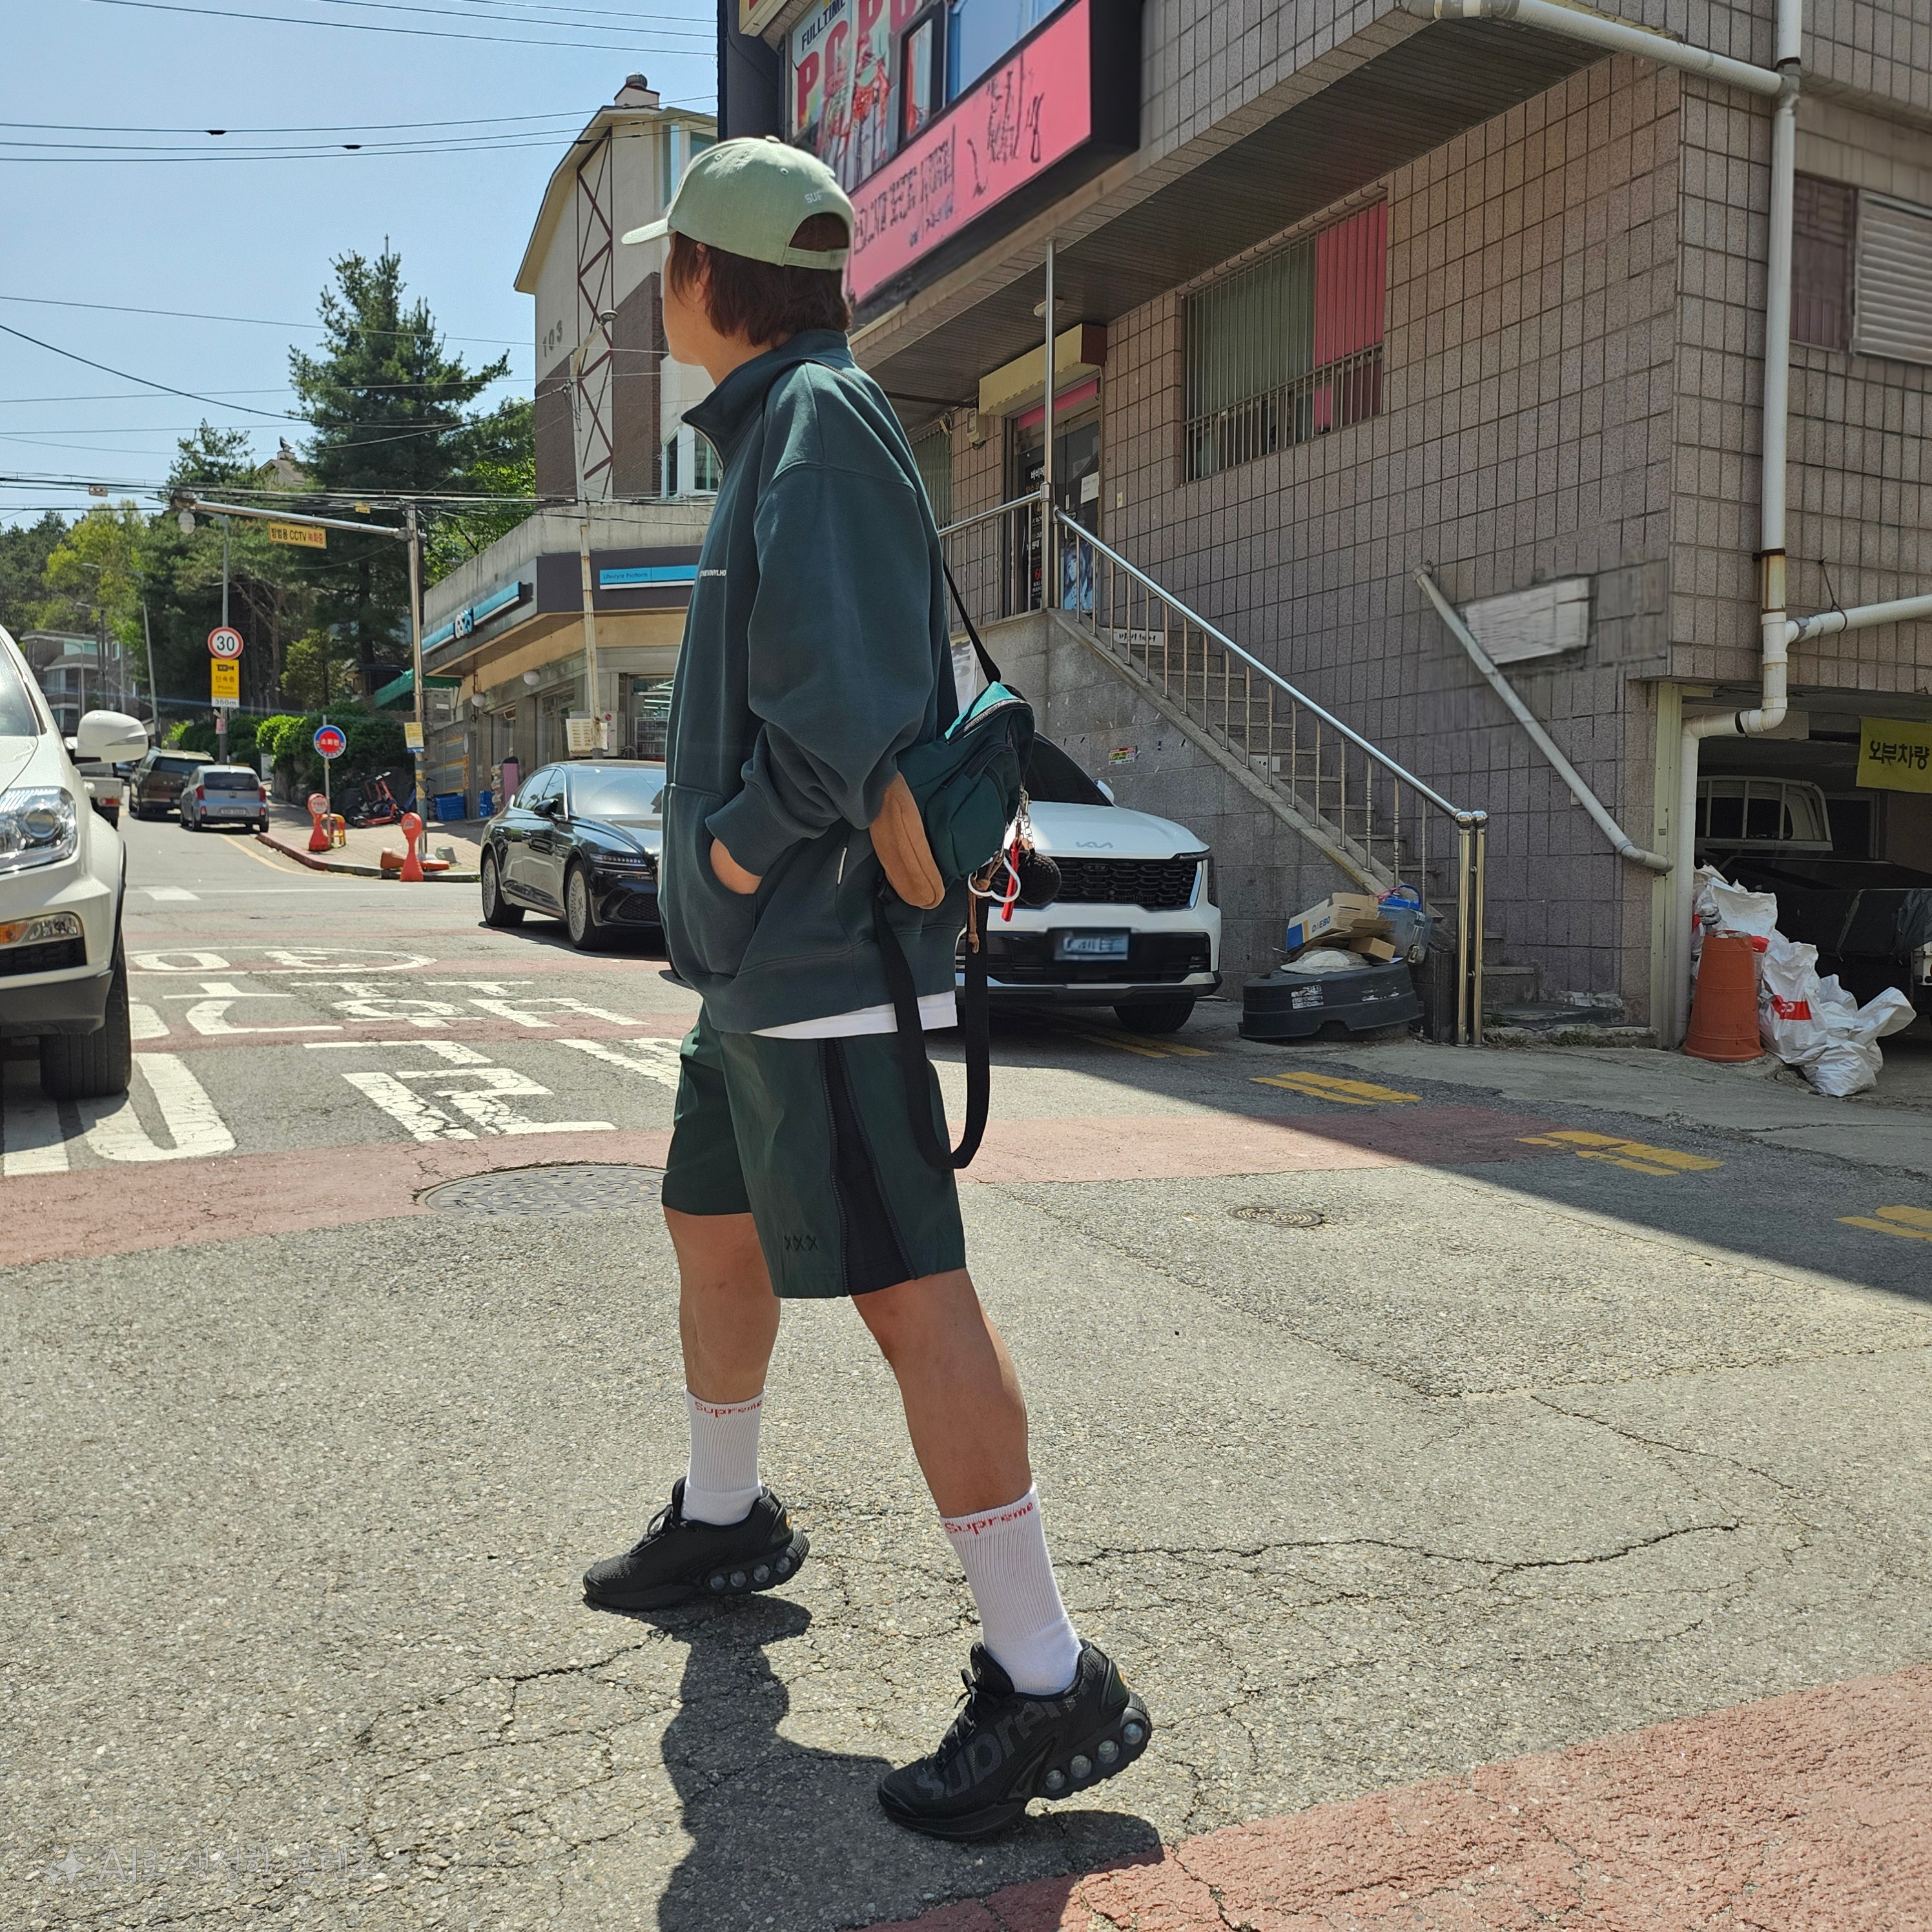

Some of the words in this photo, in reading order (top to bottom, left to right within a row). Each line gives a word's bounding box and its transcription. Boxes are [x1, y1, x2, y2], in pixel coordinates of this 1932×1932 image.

[289, 530, 307, 541] CCTV
[216, 635, 235, 651] 30
[695, 1399, 763, 1418] Supreme
[944, 1502, 1033, 1535] Supreme
